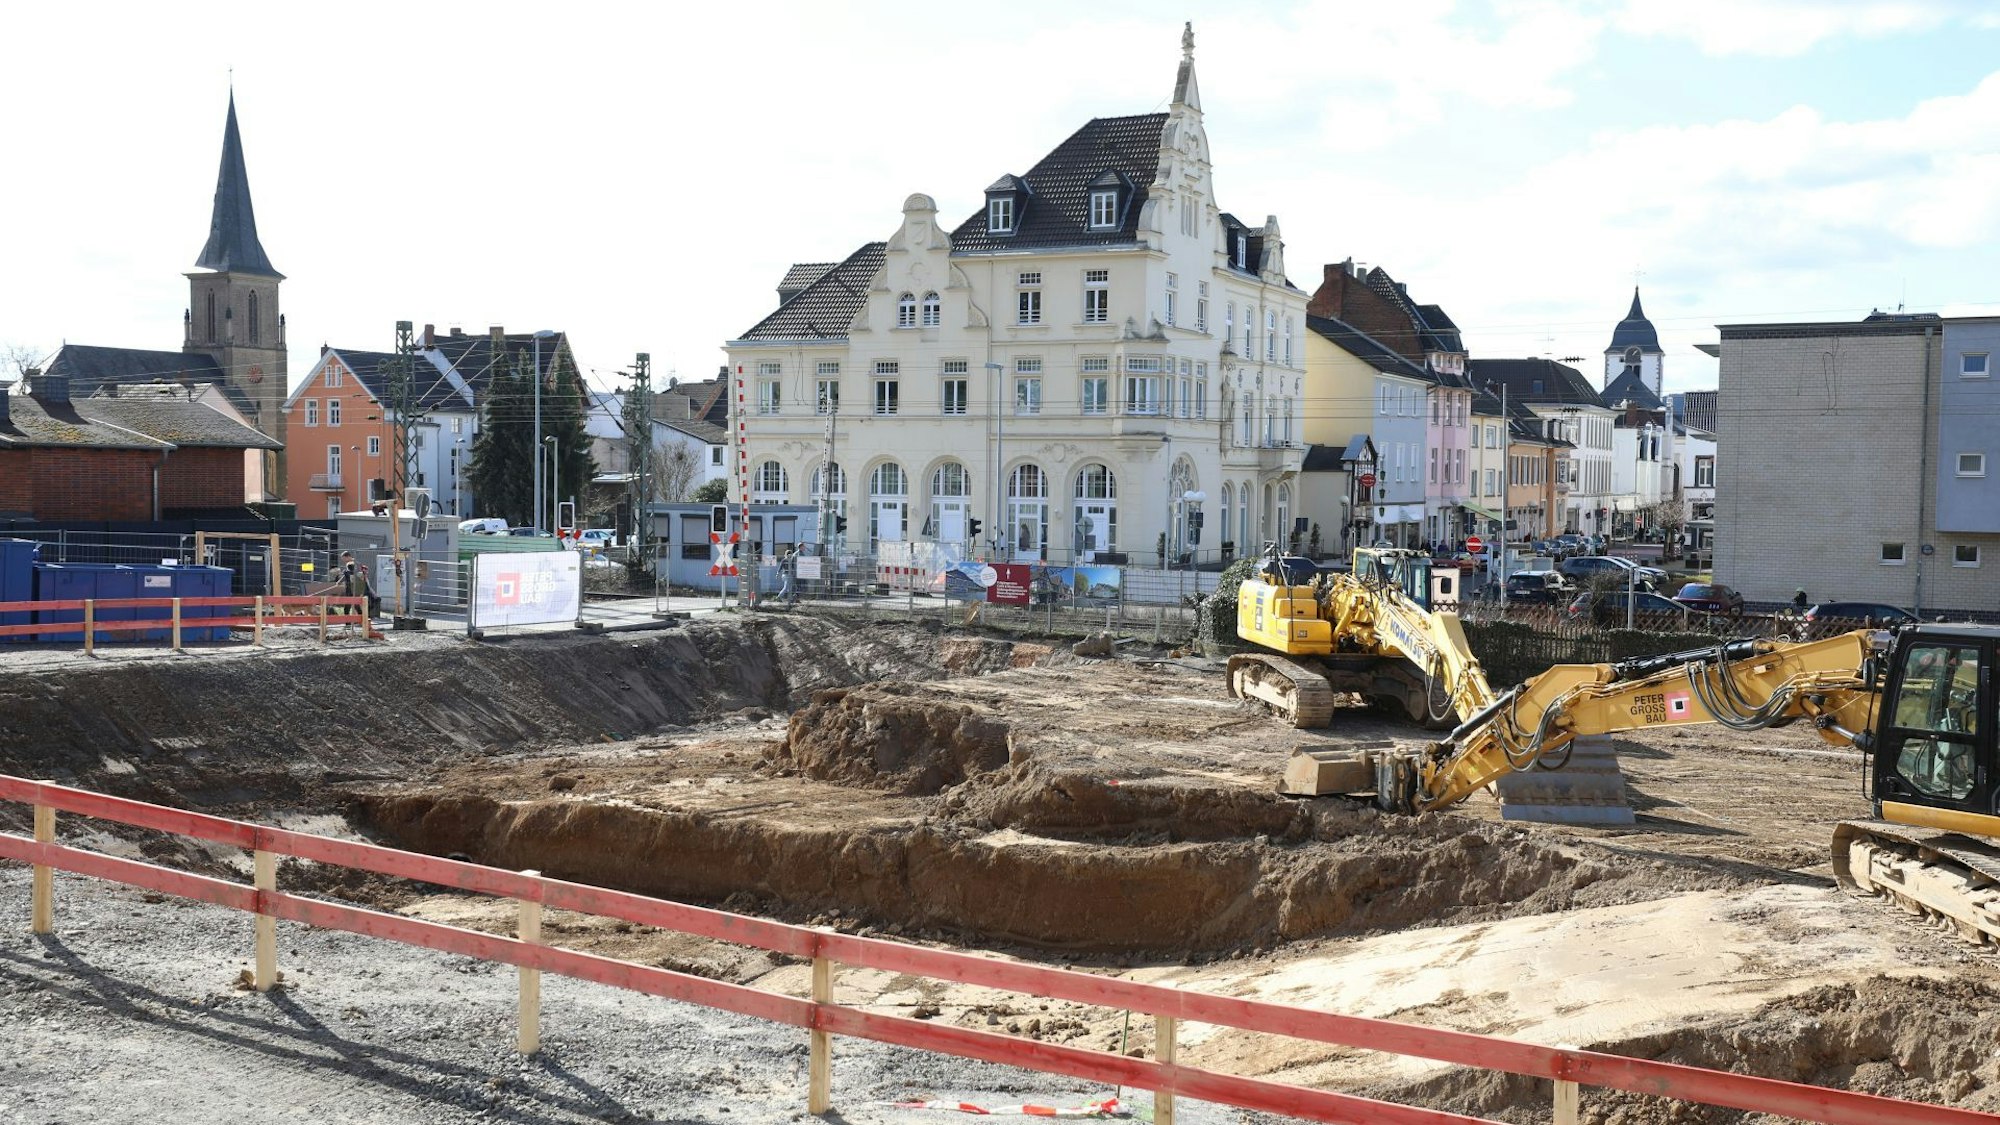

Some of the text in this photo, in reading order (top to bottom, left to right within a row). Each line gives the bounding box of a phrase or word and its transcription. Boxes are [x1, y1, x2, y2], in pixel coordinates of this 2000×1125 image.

[1634, 693, 1665, 705] PETER
[1630, 703, 1666, 715] GROSS
[1645, 713, 1667, 724] BAU
